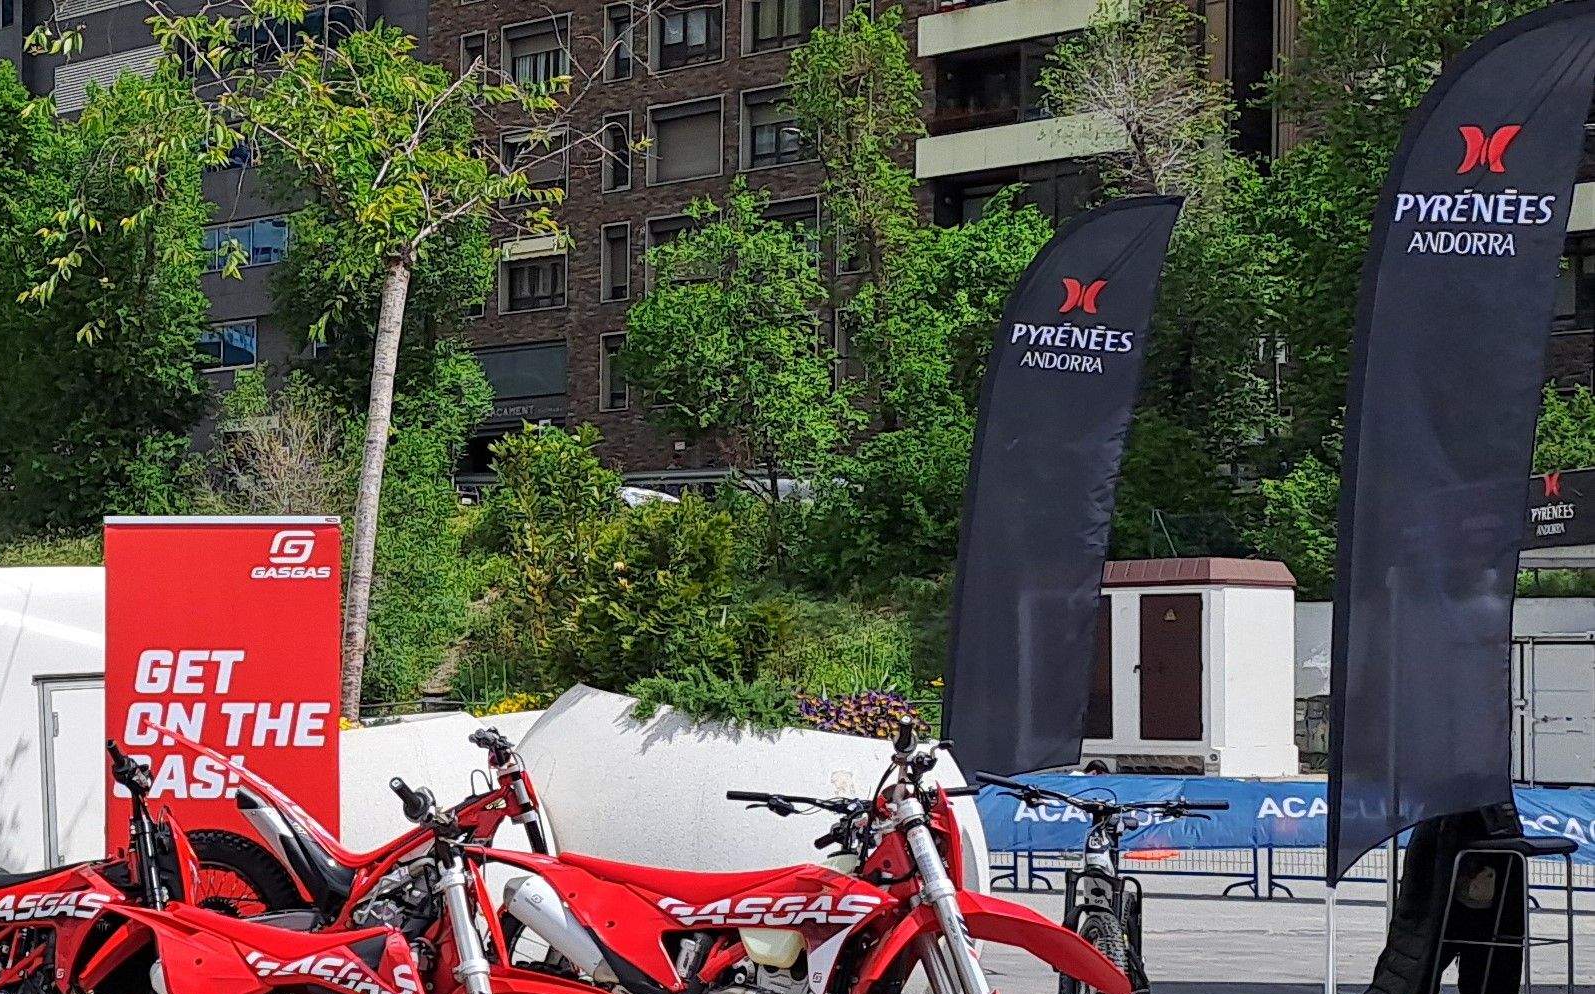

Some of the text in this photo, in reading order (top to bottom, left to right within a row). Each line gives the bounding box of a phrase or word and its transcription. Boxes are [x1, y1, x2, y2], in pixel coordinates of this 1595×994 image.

[1394, 188, 1556, 224] PYRÉNÉES
[1407, 231, 1516, 256] ANDORRA
[1011, 322, 1134, 352] PYRÉNÉES
[1019, 351, 1104, 374] ANDORRA
[251, 566, 332, 579] GASGAS
[134, 650, 245, 695] GET
[124, 702, 331, 748] ON THE
[1014, 799, 1090, 823] ACA
[1257, 797, 1331, 820] ACA
[657, 895, 882, 927] GASGAS
